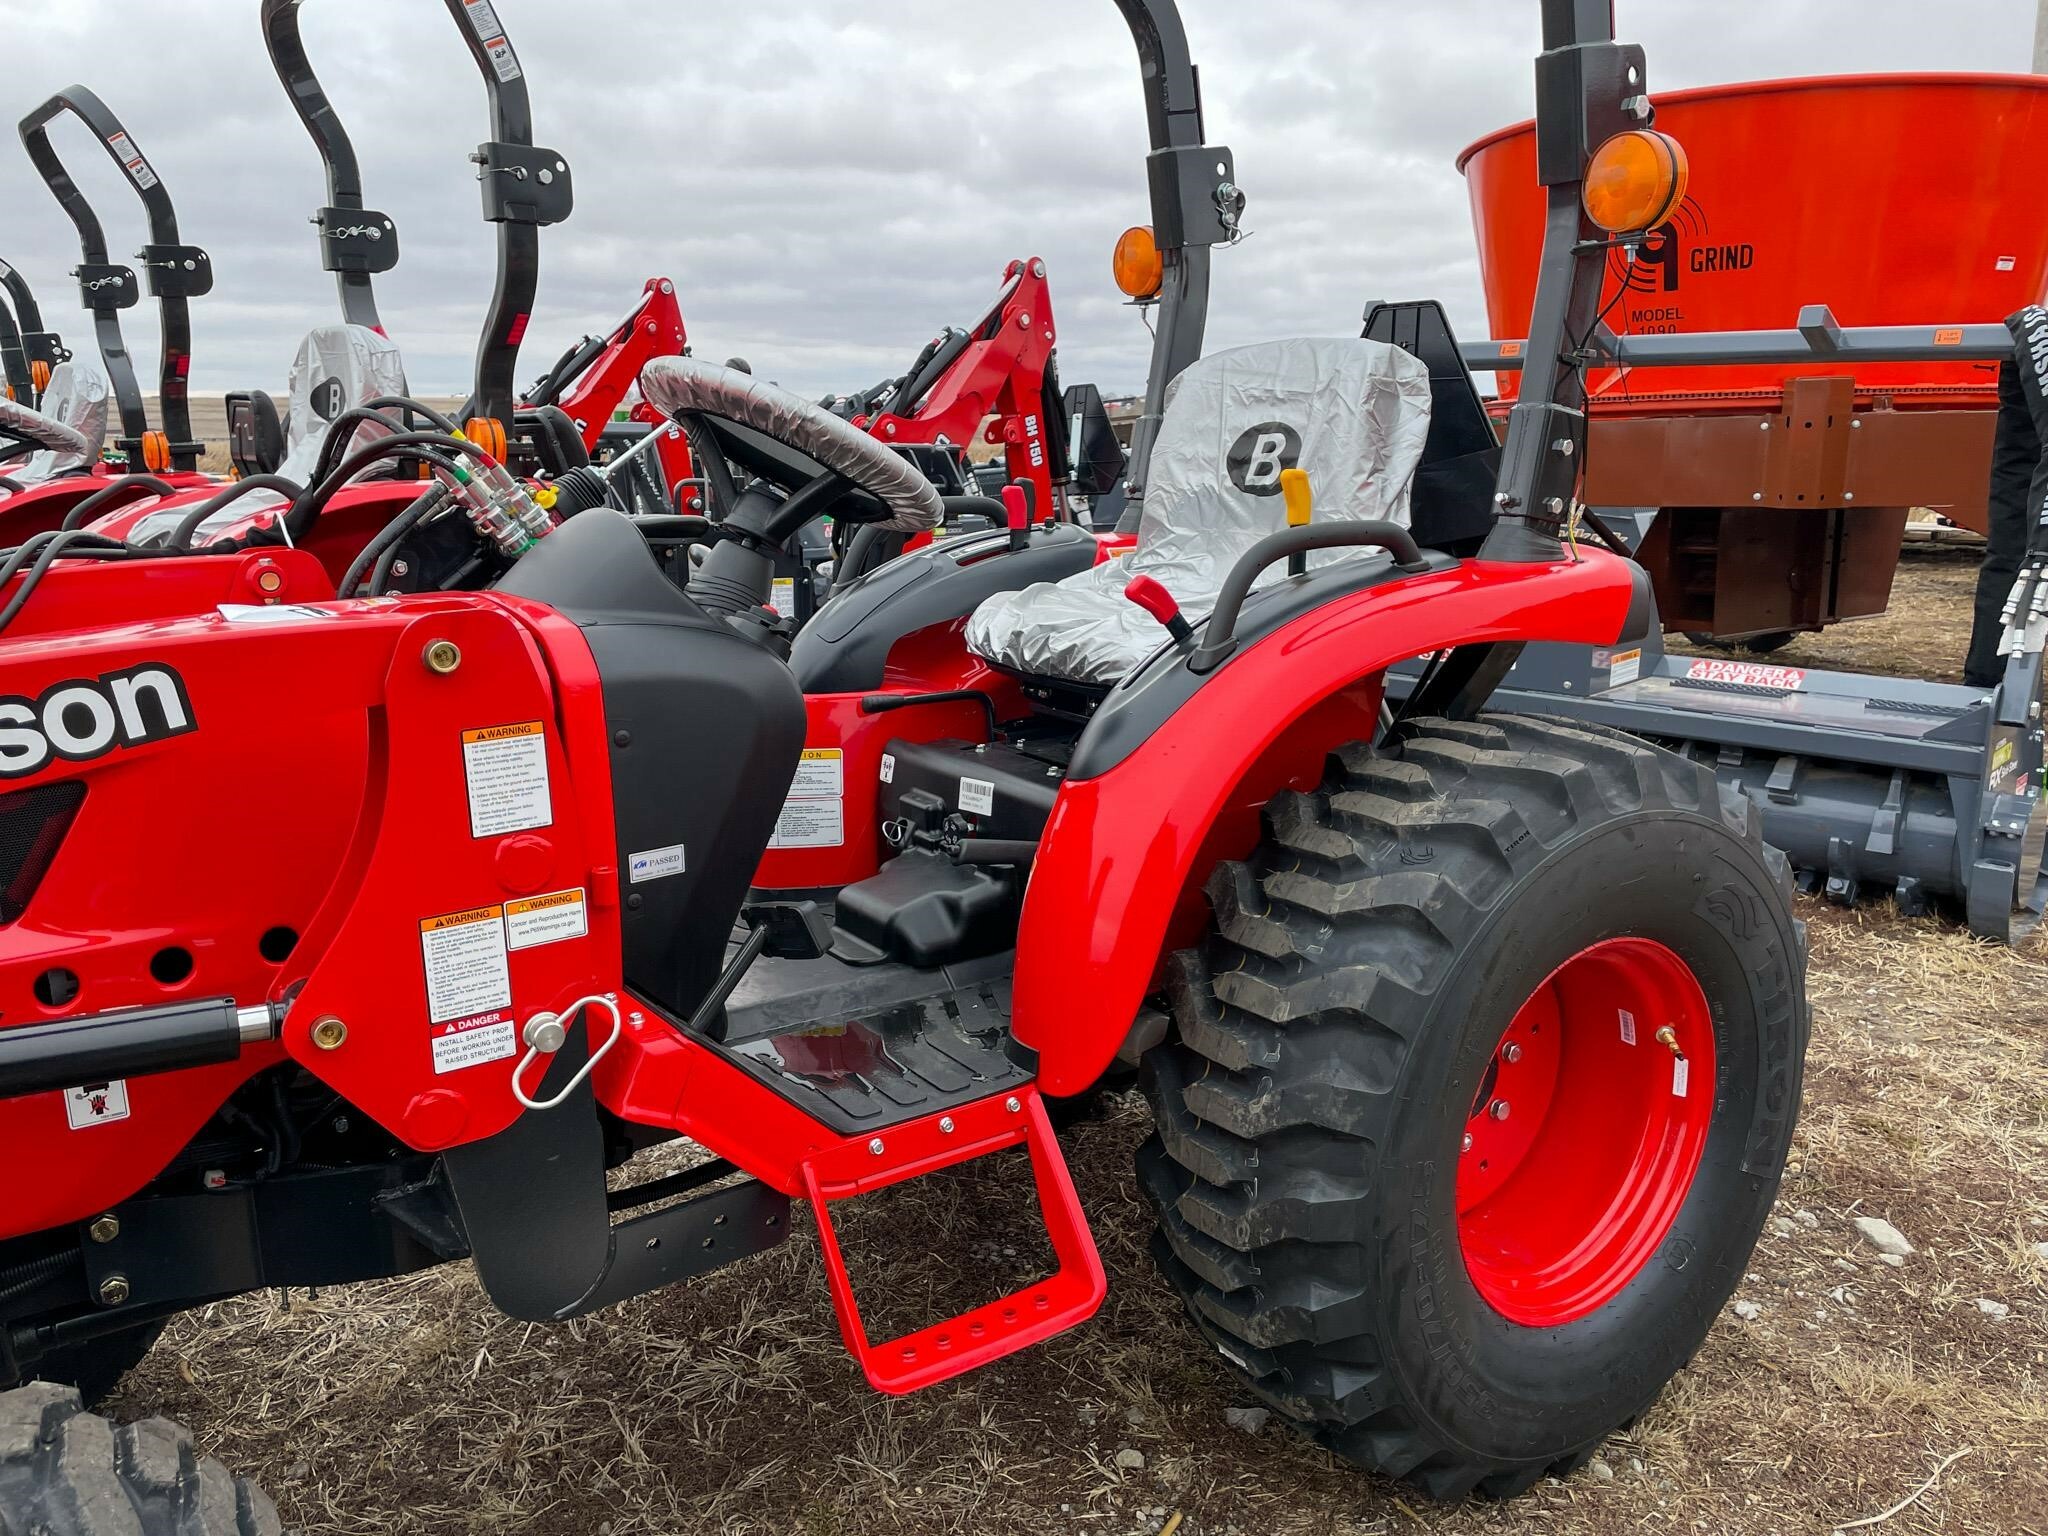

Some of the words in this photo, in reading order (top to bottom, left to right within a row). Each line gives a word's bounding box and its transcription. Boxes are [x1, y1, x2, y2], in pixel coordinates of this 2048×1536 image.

[1690, 244, 1754, 272] GRIND
[1632, 308, 1684, 322] MODEL
[1025, 415, 1038, 437] BH
[1029, 439, 1043, 467] 150
[1245, 433, 1286, 485] B
[1691, 669, 1740, 682] STAY
[1744, 675, 1797, 688] BACK
[1709, 662, 1785, 679] DANGER
[0, 671, 187, 771] son
[486, 725, 531, 738] WARNING
[1503, 830, 1530, 854] TIRON
[649, 855, 680, 867] PASSED
[530, 894, 572, 909] WARNING
[445, 910, 490, 925] WARNING
[510, 920, 527, 928] Cancer
[539, 912, 568, 922] Reproductive
[458, 1013, 500, 1030] DANGER
[435, 1048, 460, 1058] BEFORE
[462, 1040, 491, 1051] WORKING
[493, 1034, 514, 1044] UNDER
[438, 1038, 464, 1048] INSTALL
[466, 1031, 489, 1042] SAFETY
[492, 1026, 508, 1035] PROP
[445, 1054, 468, 1064] RAISED
[470, 1045, 505, 1058] STRUCTURE
